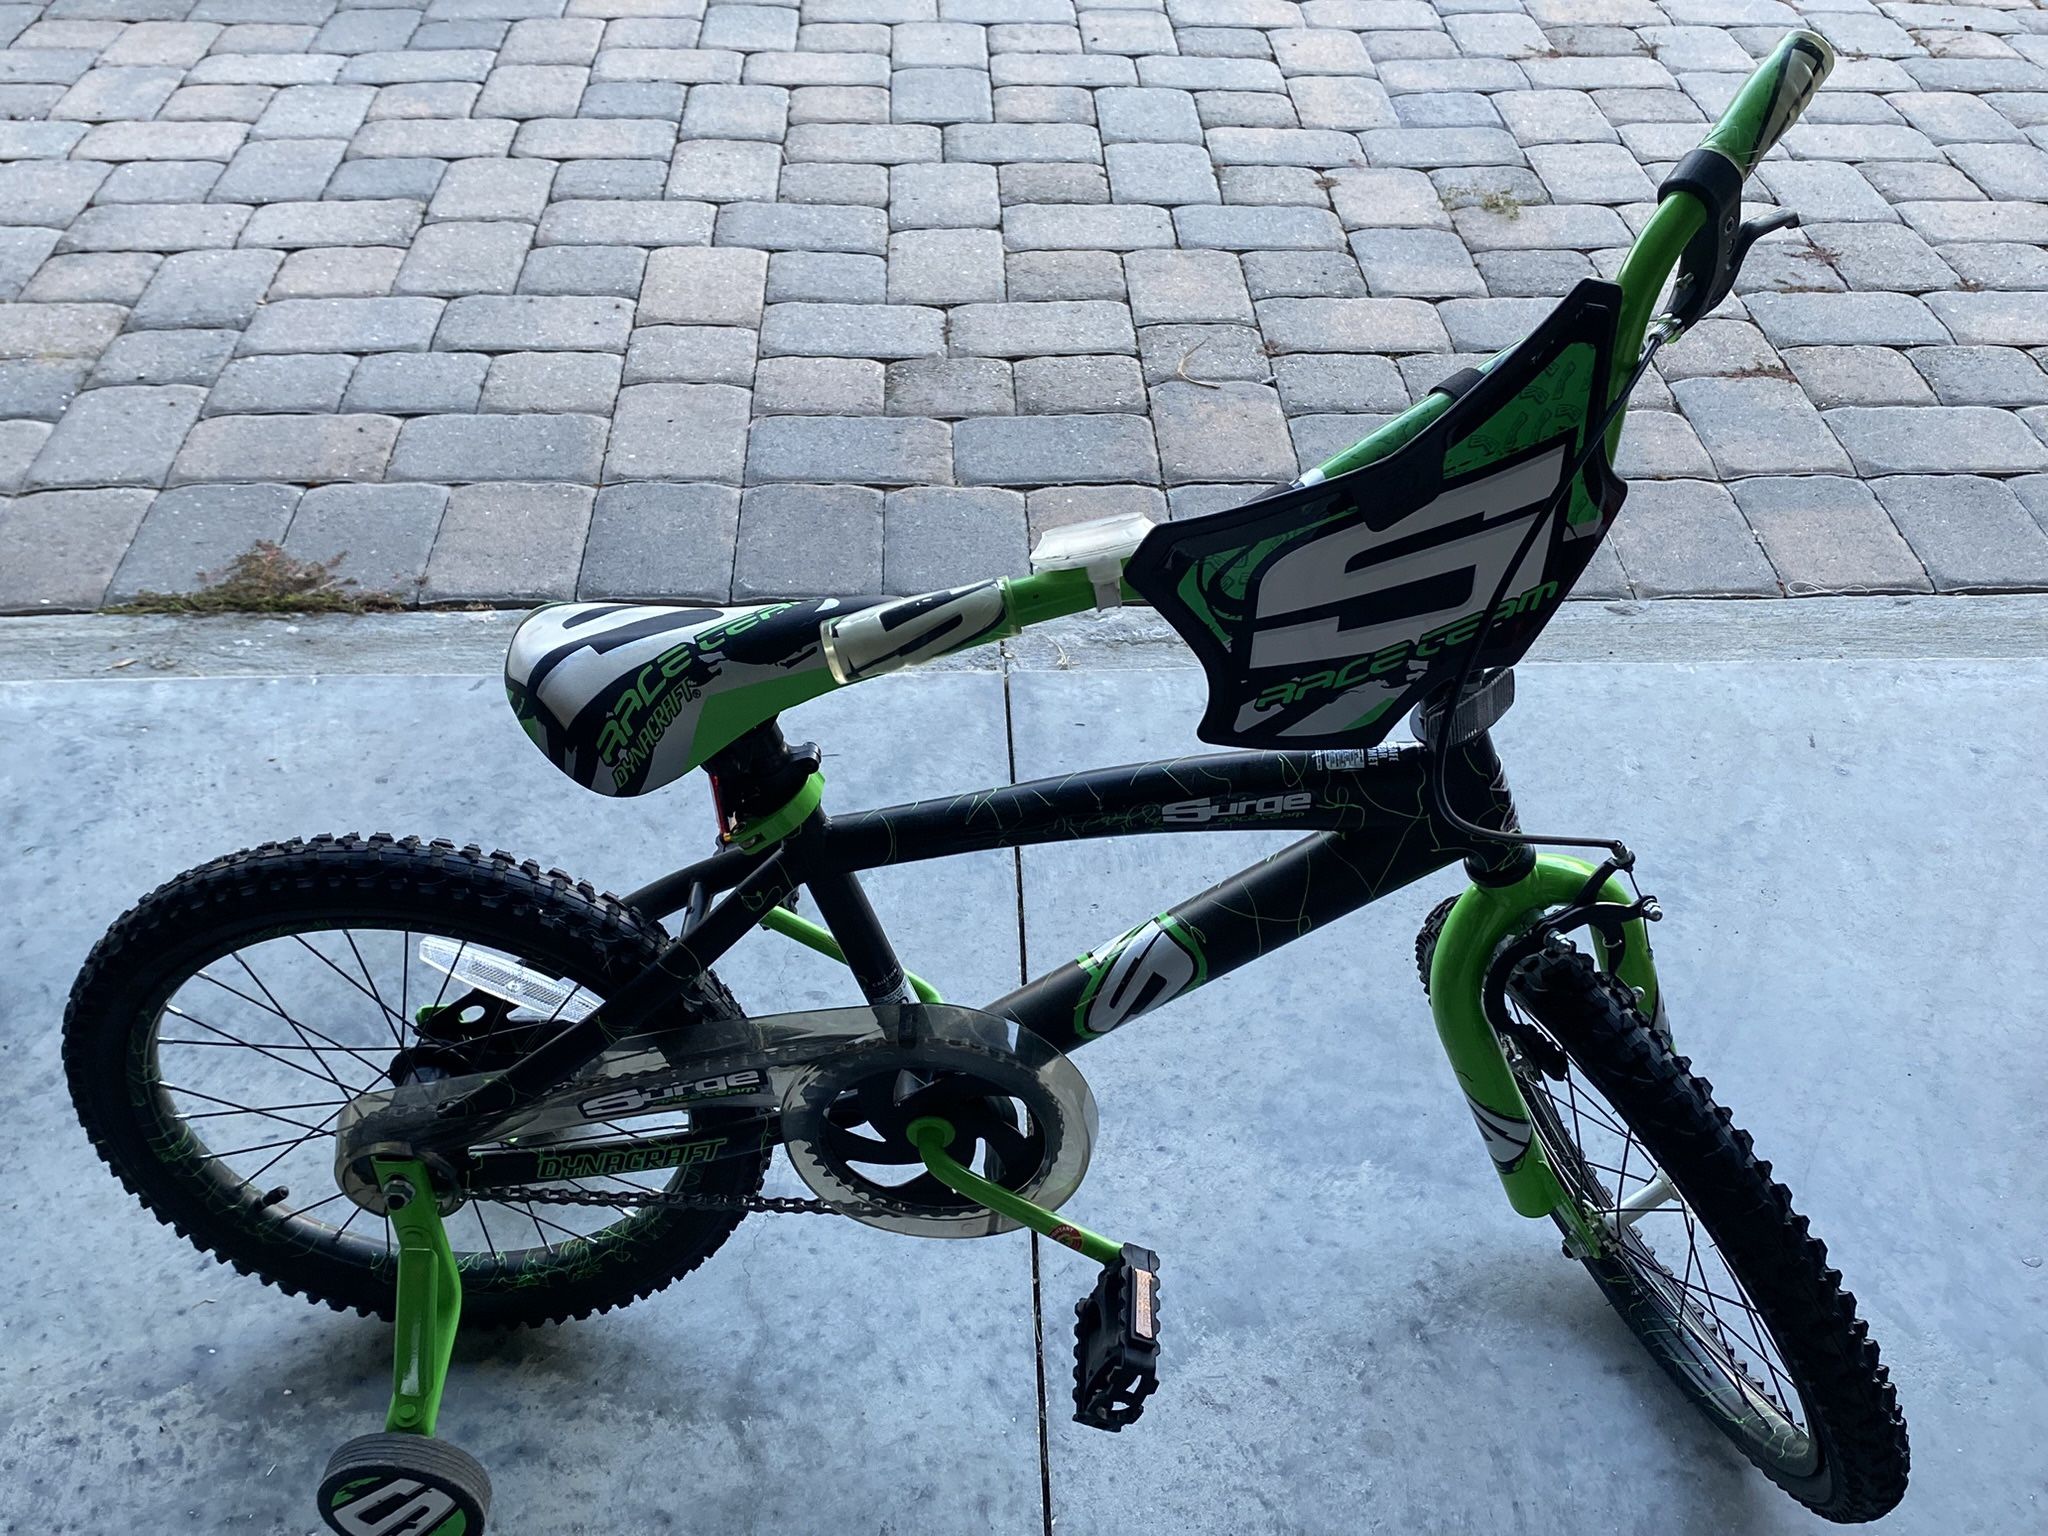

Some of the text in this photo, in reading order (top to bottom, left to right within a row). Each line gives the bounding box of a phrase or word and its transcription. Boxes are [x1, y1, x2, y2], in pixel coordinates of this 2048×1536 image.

[1162, 792, 1312, 823] Surge
[582, 1069, 760, 1117] Surge
[537, 1138, 728, 1179] DYNACRAFT
